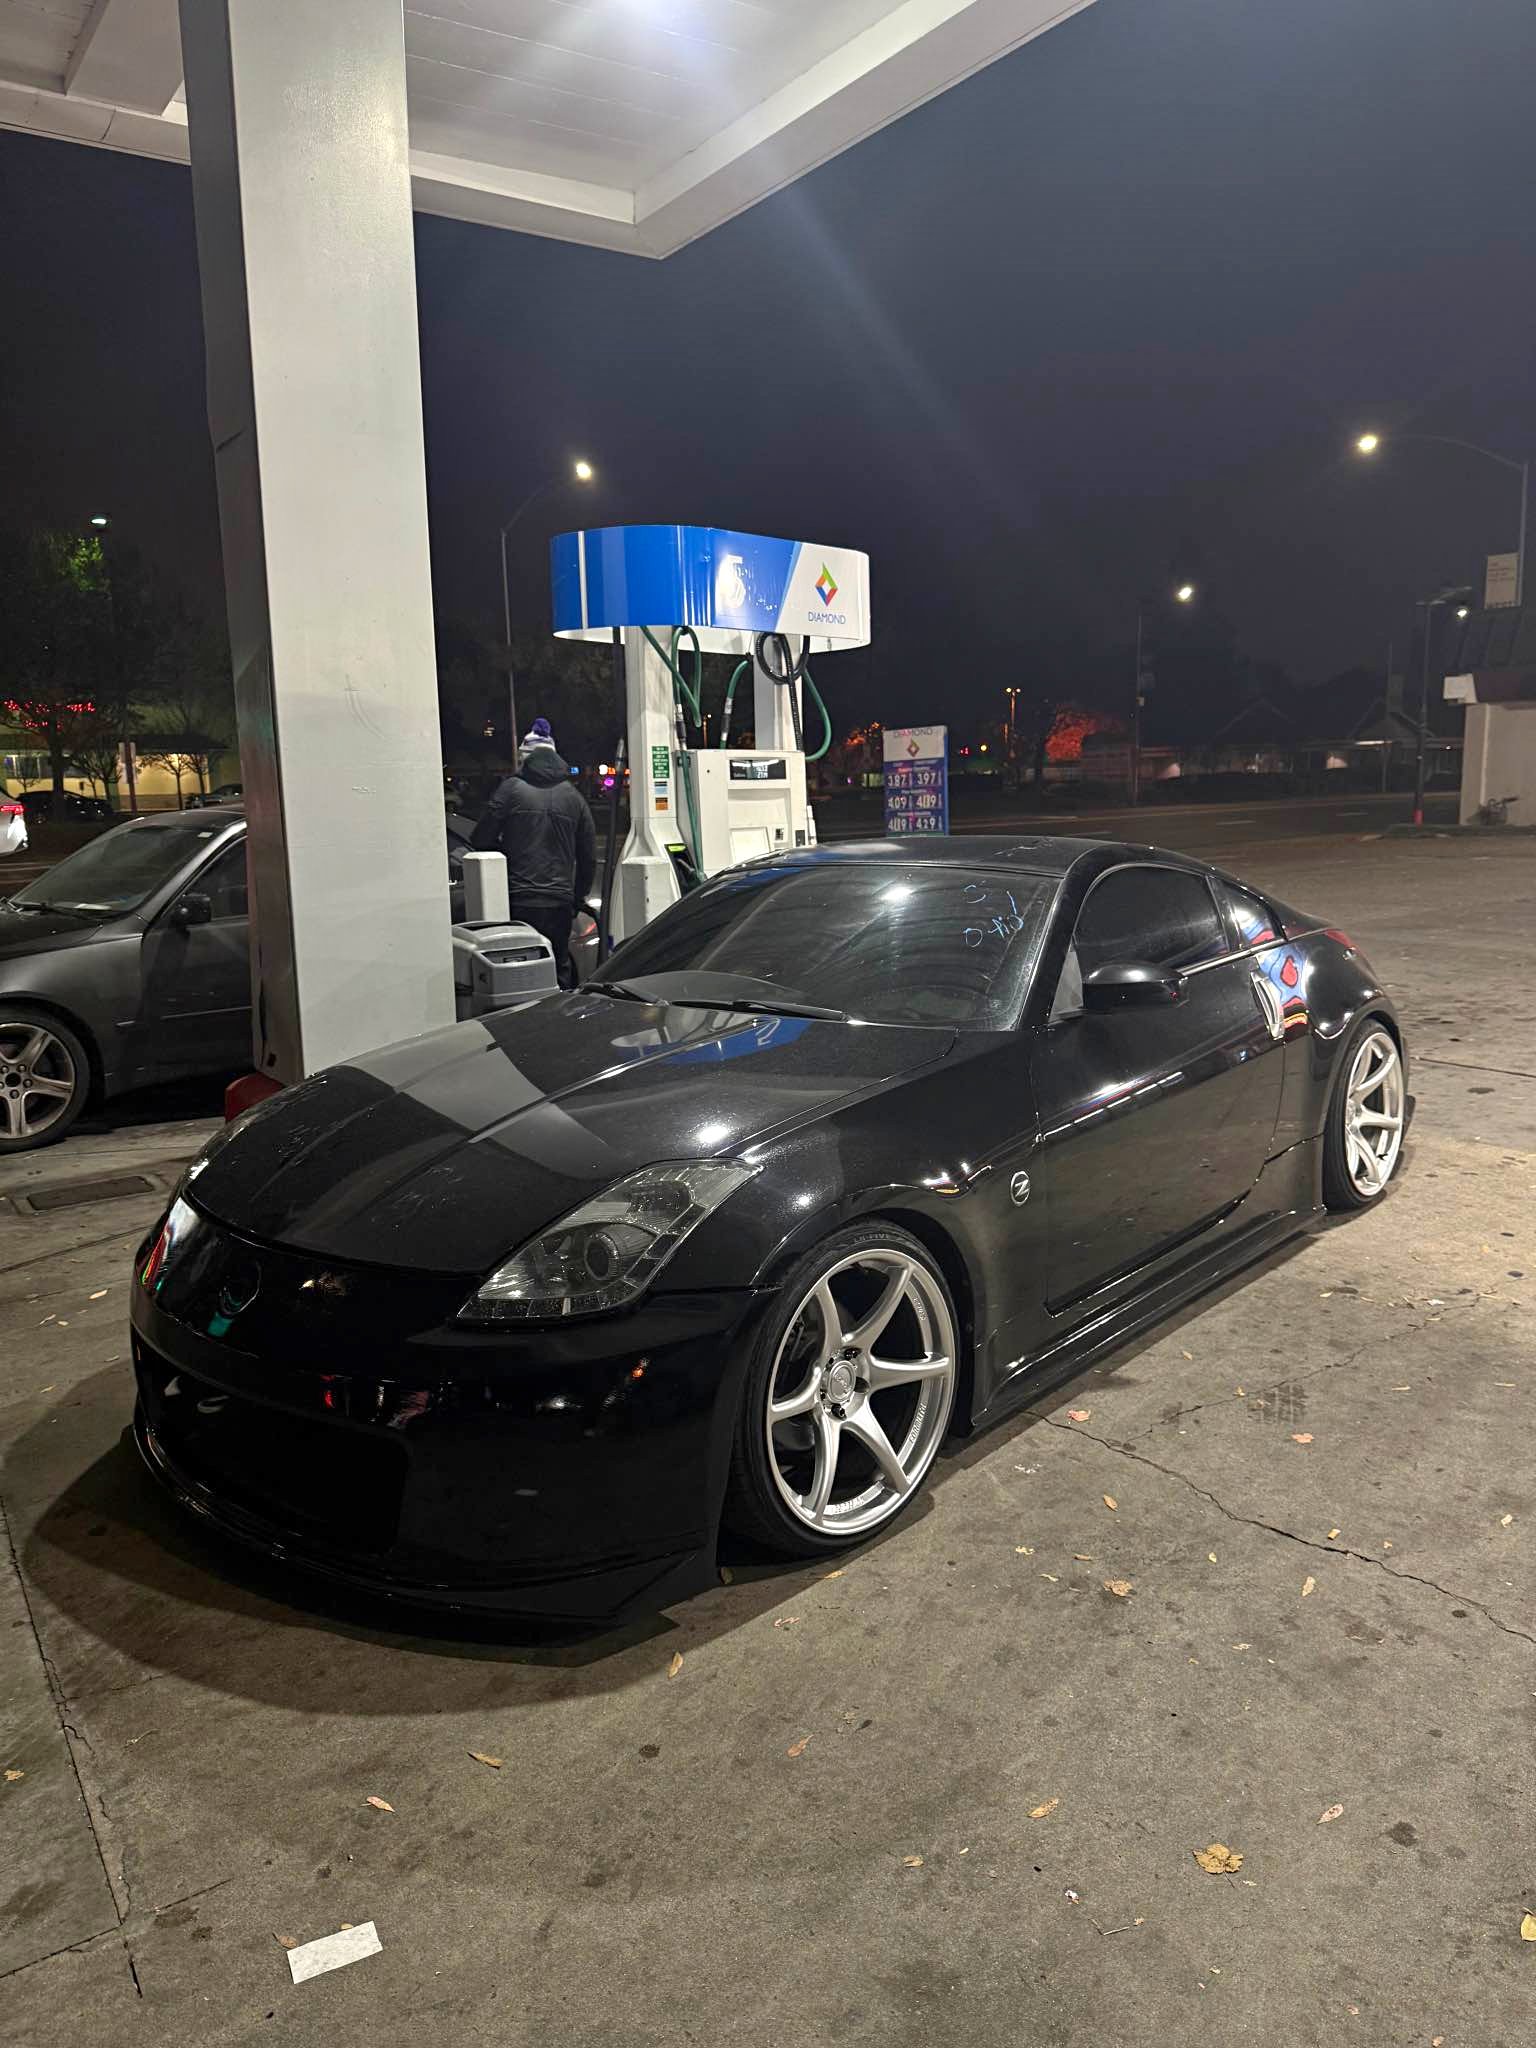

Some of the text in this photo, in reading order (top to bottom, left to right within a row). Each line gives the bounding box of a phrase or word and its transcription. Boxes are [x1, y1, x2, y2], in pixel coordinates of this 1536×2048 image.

[807, 611, 847, 625] DIAMOND
[887, 772, 937, 788] 387 397
